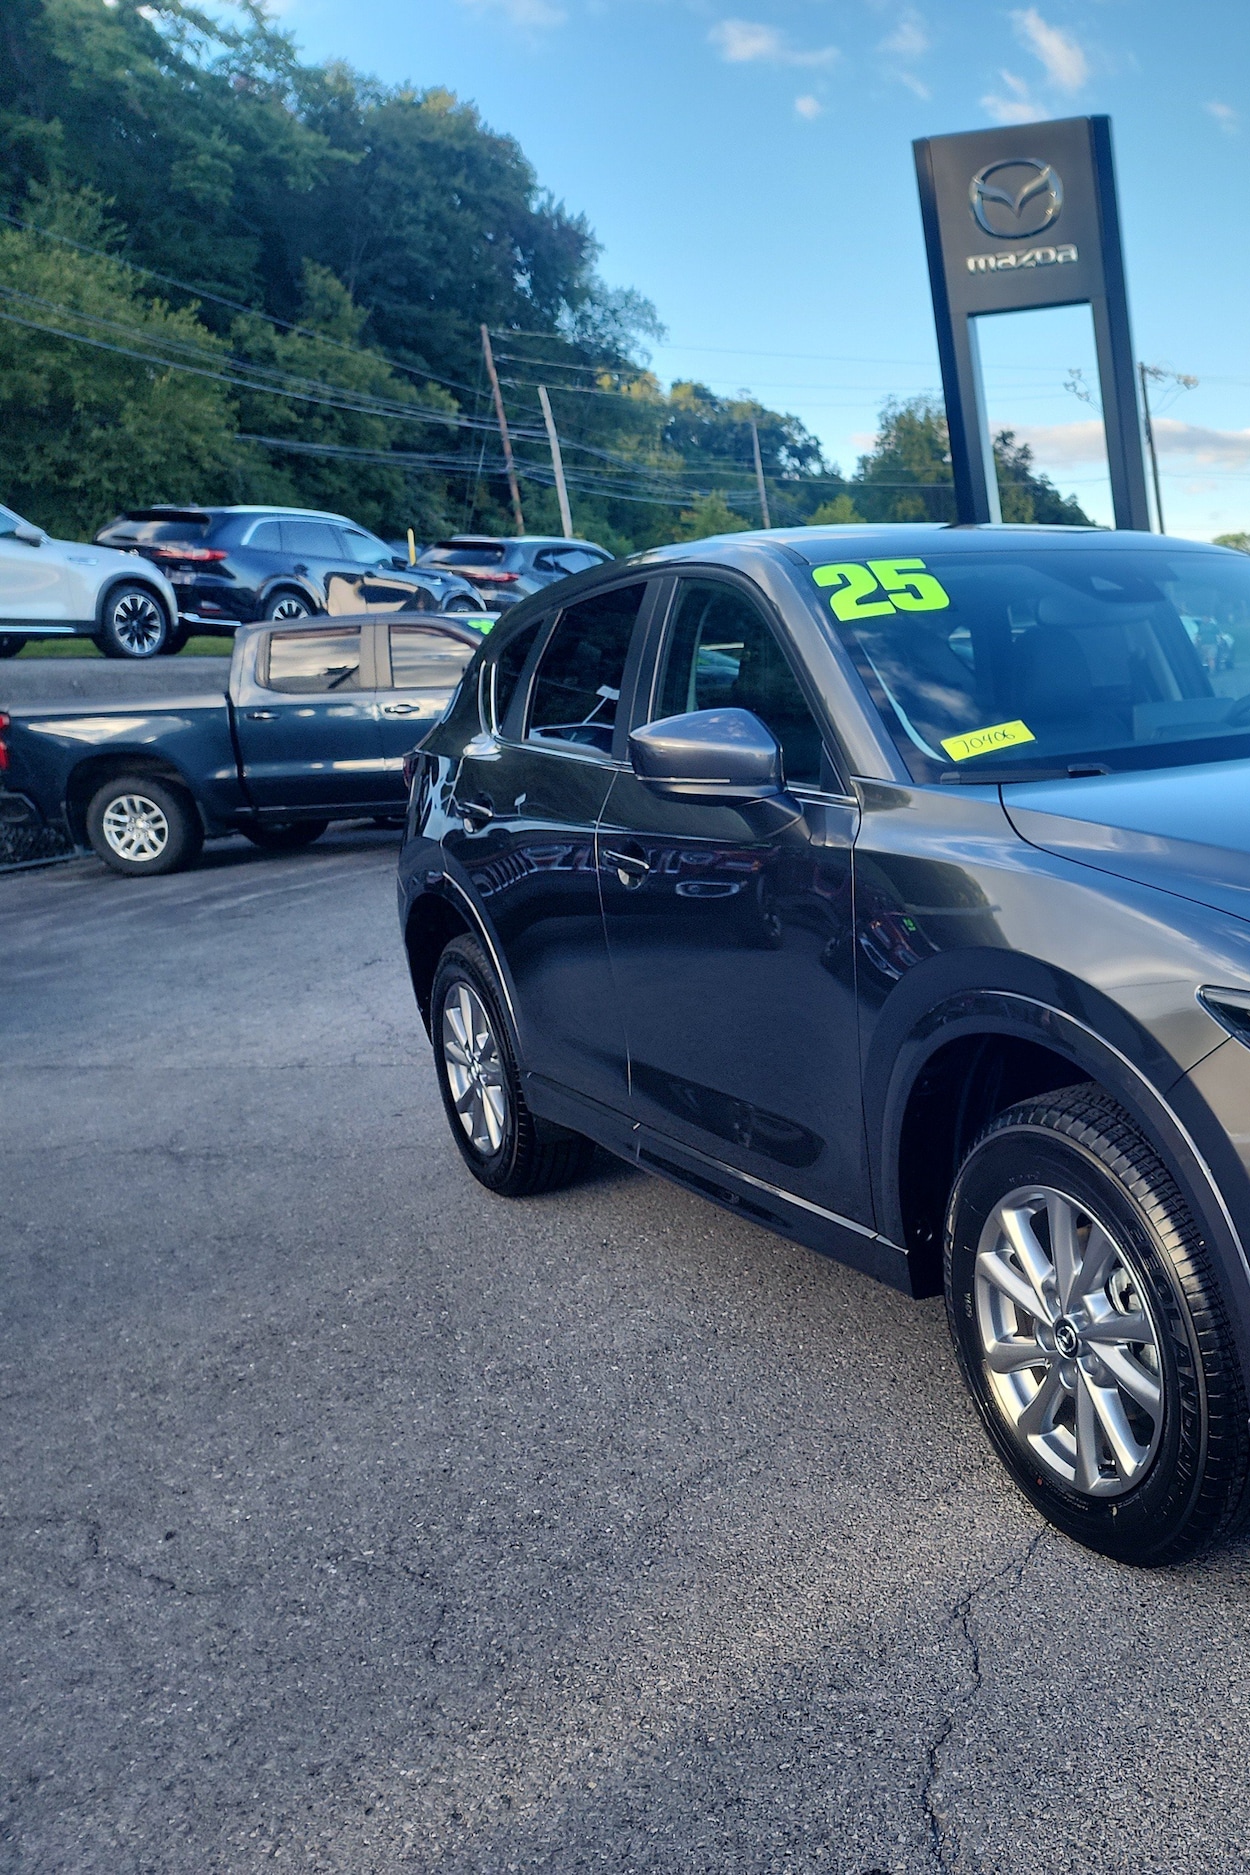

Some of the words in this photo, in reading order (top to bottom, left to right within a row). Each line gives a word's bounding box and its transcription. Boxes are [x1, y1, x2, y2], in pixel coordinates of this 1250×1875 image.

[966, 243, 1079, 275] mazda
[812, 559, 950, 621] 25
[953, 729, 1016, 753] 70406
